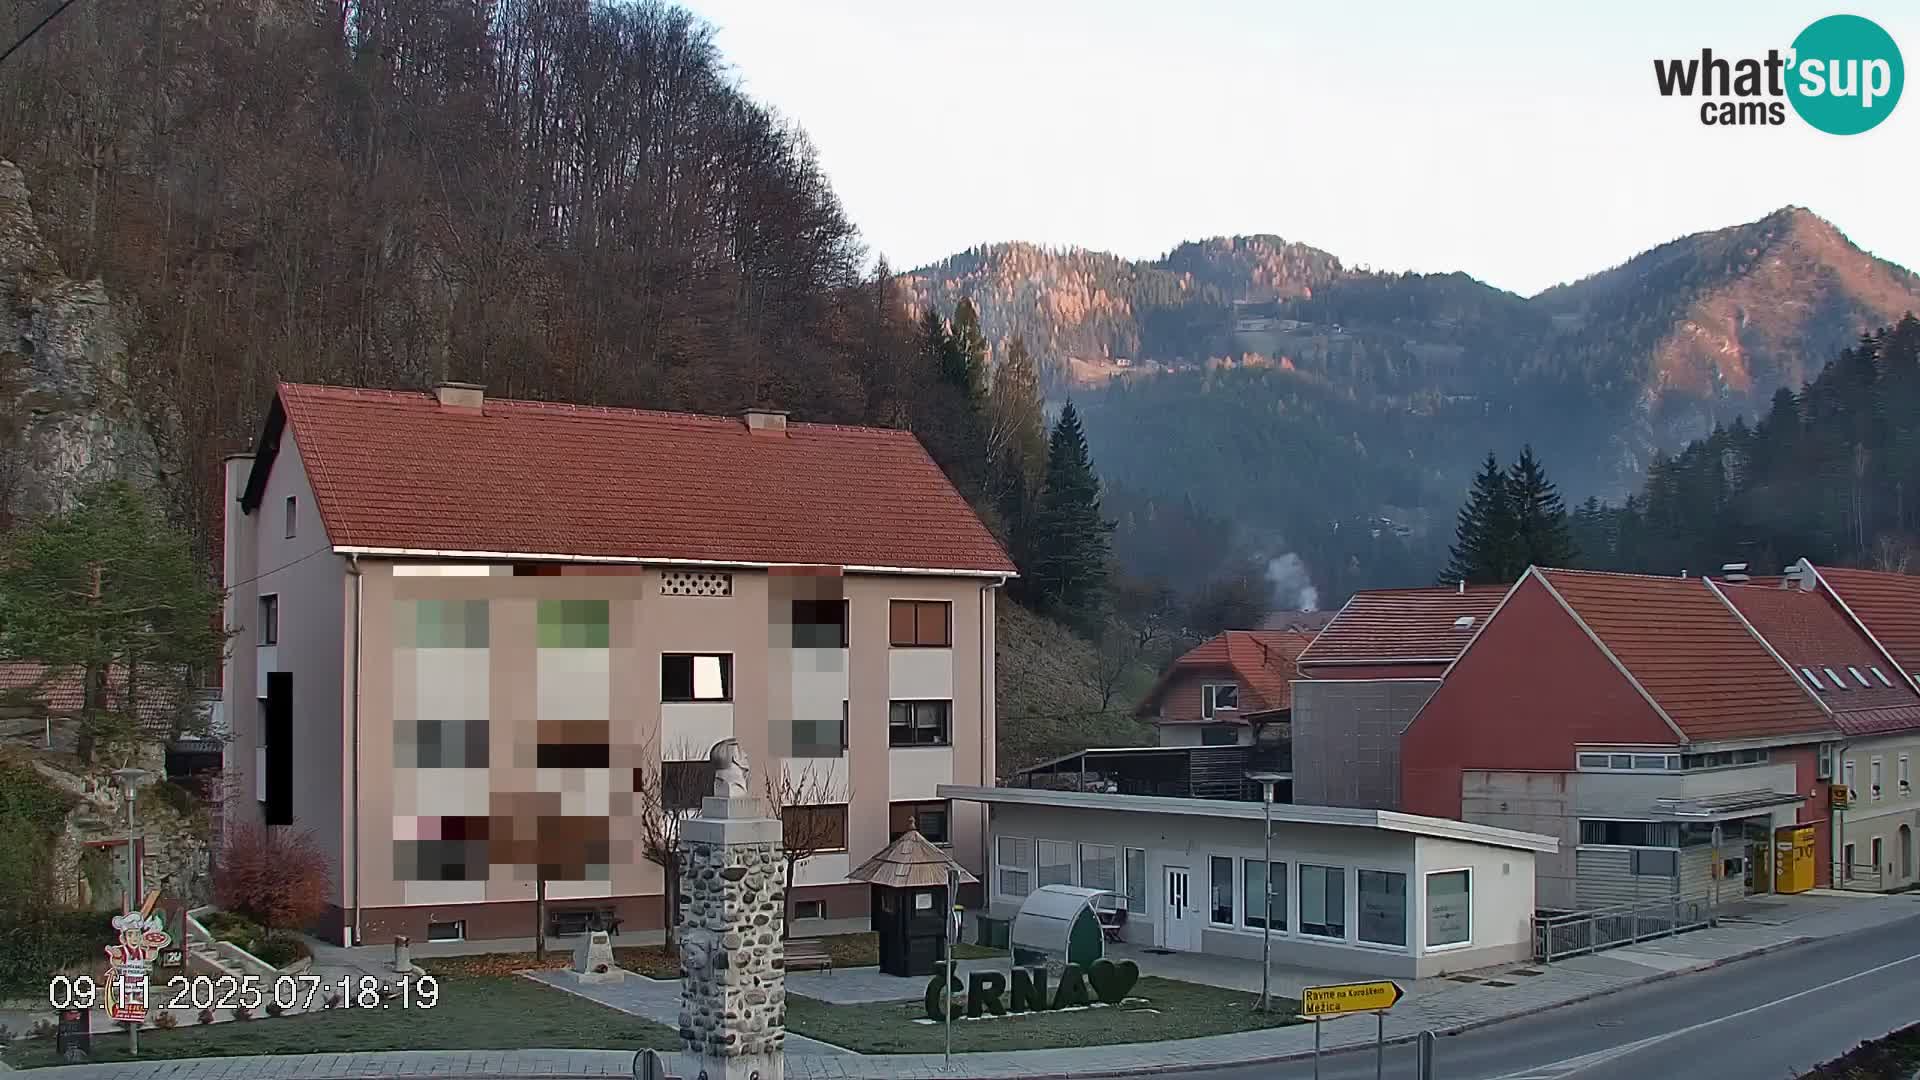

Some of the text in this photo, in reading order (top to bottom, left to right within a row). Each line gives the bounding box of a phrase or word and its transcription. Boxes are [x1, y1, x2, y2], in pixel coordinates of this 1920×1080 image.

[1306, 989, 1335, 1001] Ravne
[1337, 991, 1347, 999] na
[1306, 1001, 1341, 1013] Mežica
